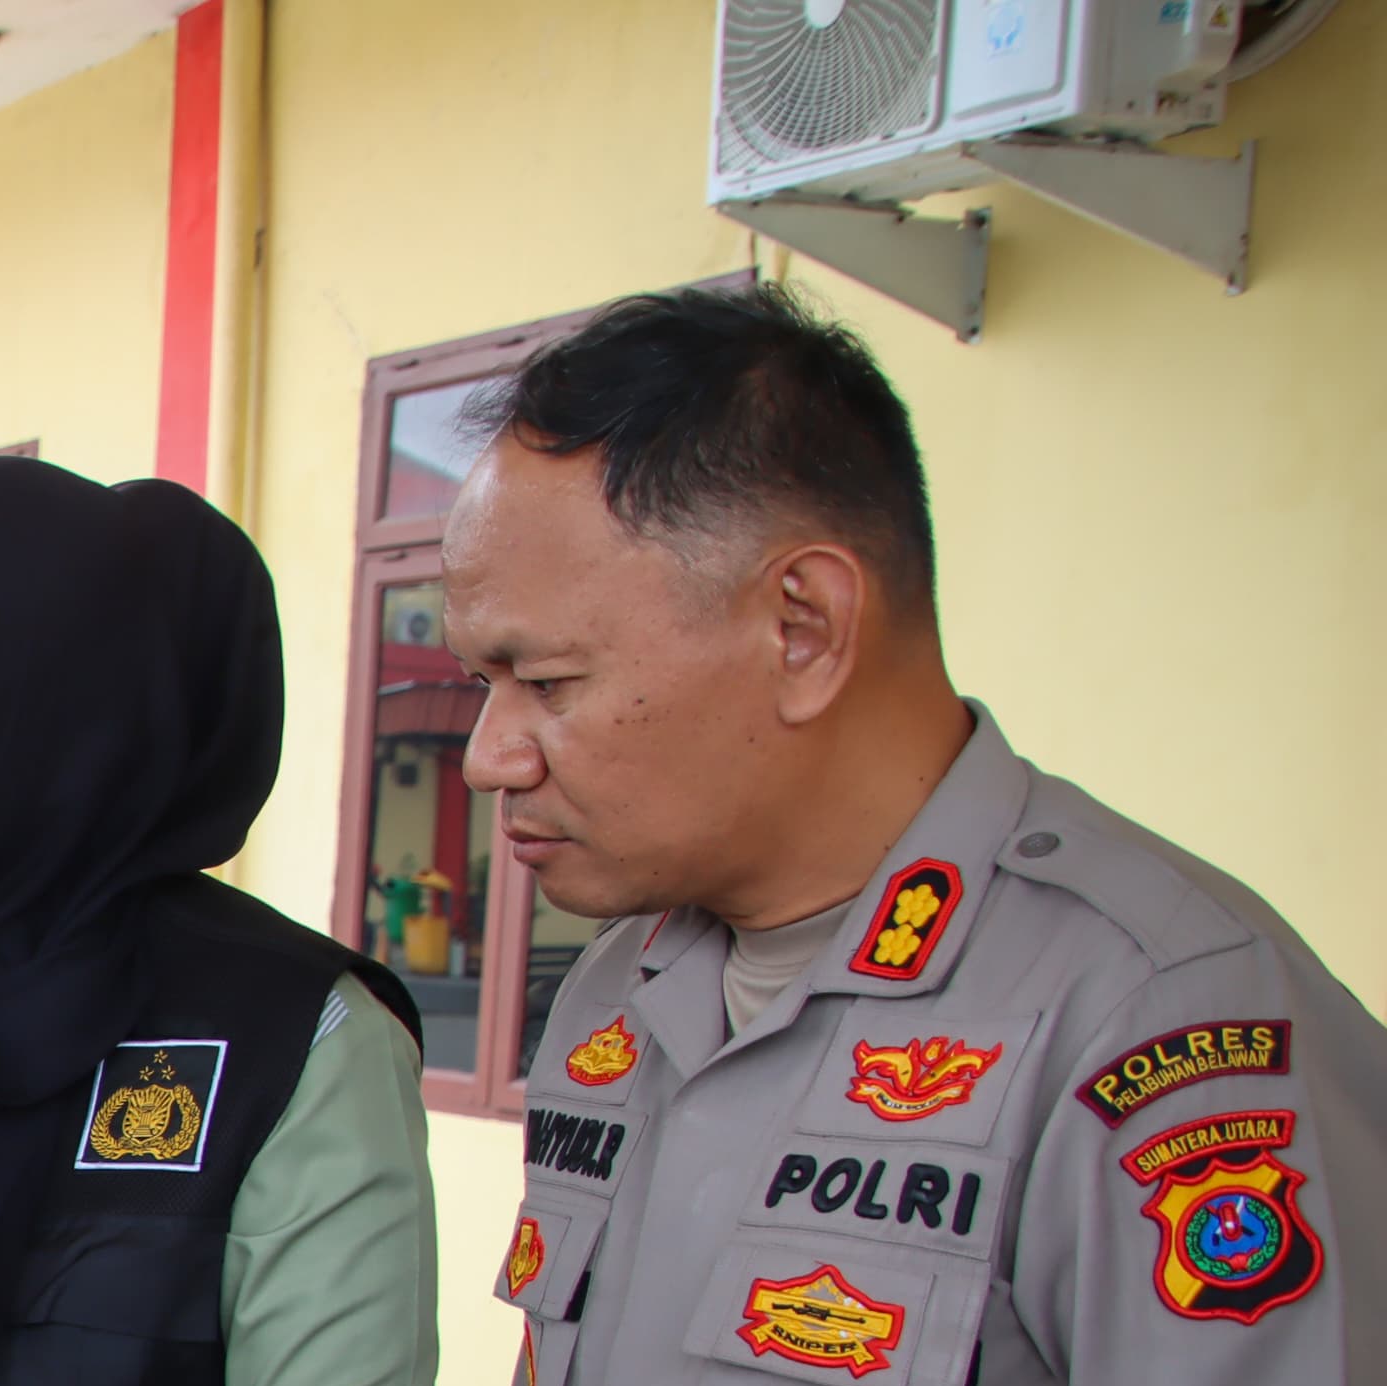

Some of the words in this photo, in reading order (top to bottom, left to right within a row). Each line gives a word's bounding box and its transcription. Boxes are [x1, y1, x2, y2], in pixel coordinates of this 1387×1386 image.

[1094, 1026, 1275, 1104] POLRES
[1112, 1057, 1196, 1113] PELABUHAN
[1195, 1050, 1270, 1072] BELAWAN
[1136, 1125, 1222, 1172] SUMATERA
[1224, 1119, 1278, 1142] UTARA
[764, 1152, 981, 1236] POLRI
[771, 1324, 857, 1353] SNIPER
